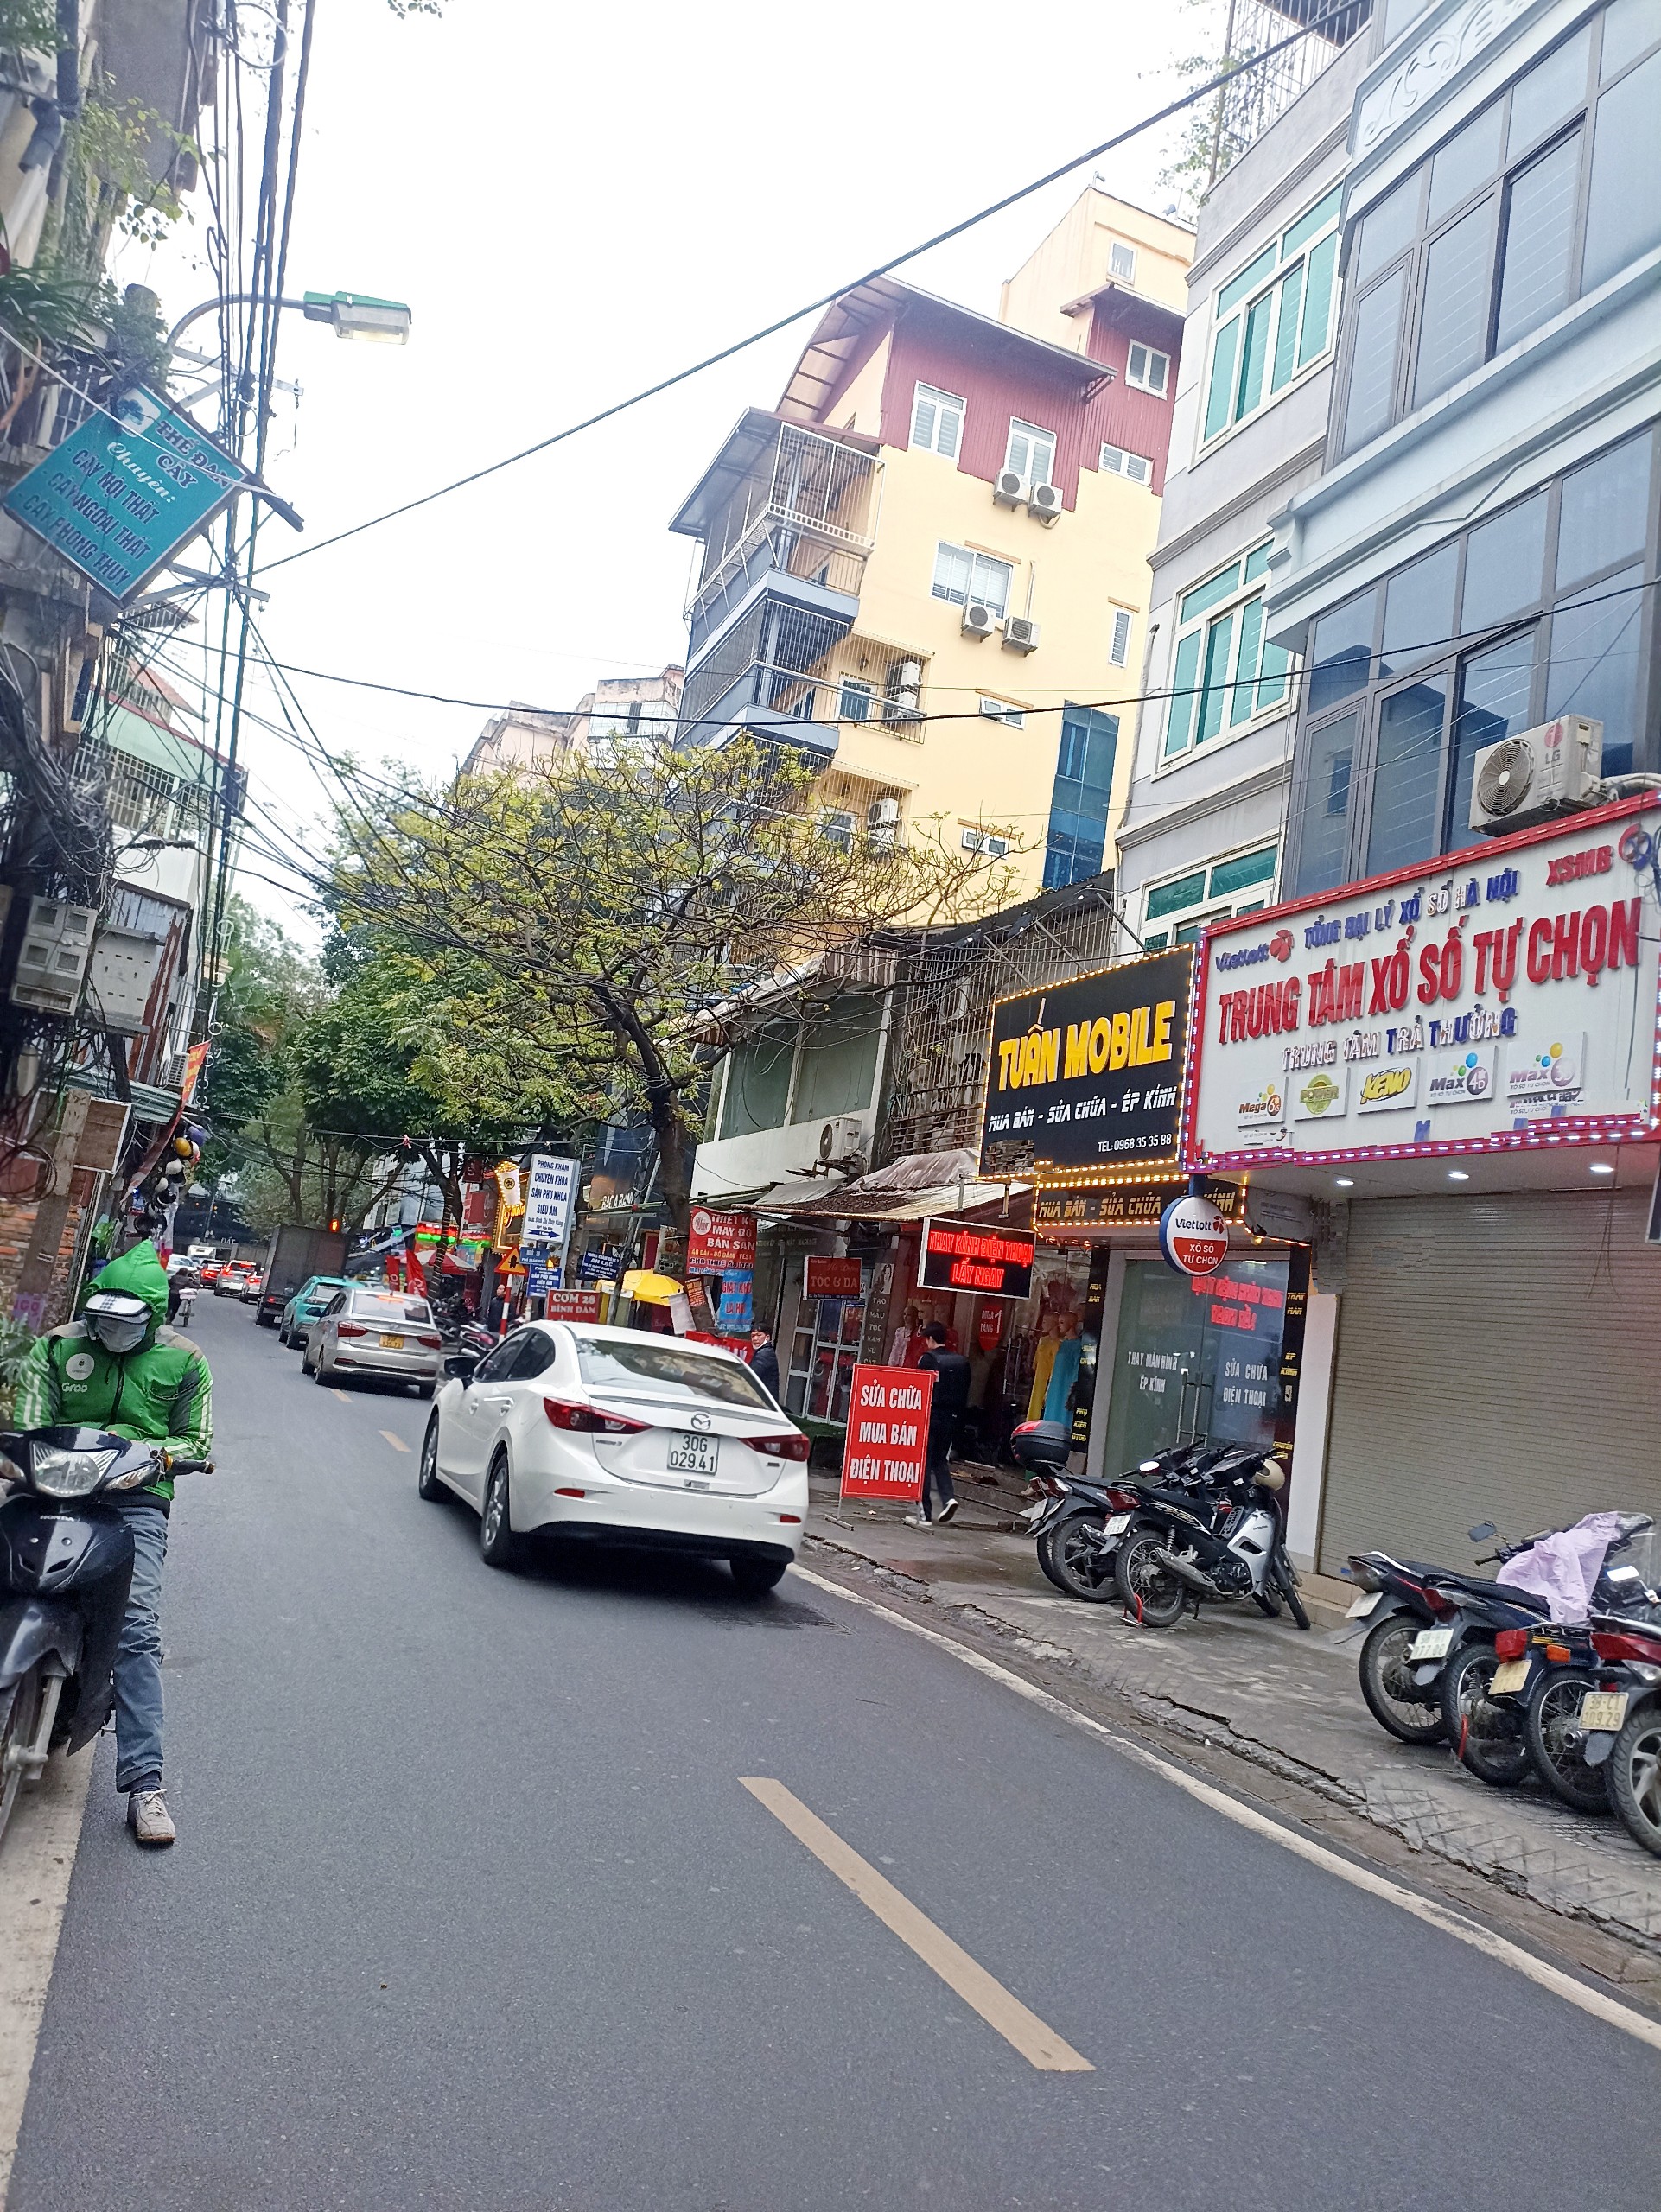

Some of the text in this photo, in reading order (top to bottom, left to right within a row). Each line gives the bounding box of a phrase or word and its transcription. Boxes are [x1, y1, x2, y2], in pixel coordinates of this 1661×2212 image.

[72, 448, 161, 524] CÂY NỘI THẤT
[52, 515, 99, 560] PHONG
[113, 525, 151, 561] THẤT
[1545, 749, 1561, 765] LG
[1546, 844, 1613, 887] XSMB
[1454, 878, 1480, 909] HÀ
[1486, 867, 1520, 903] NỘI
[1219, 896, 1644, 1045] TRUNG TÂM XỔ SỐ TỰ CHỌN
[998, 998, 1175, 1090] TUẤN MOBILE
[1282, 1003, 1518, 1071] TRUNG TÂM TRẢ THƯỞNG
[1360, 1067, 1412, 1104] KENO
[1429, 1077, 1465, 1092] Max
[1510, 1068, 1549, 1084] Max
[988, 1084, 1177, 1132] MUA BÁN SỬA CHỮA ÉP KÍNH
[1238, 1103, 1267, 1115] Mega
[1136, 1136, 1147, 1148] 35
[1148, 1135, 1159, 1147] 35
[1161, 1134, 1172, 1145] 88
[555, 1175, 568, 1186] KHOA
[553, 1192, 567, 1202] KHOA
[1039, 1200, 1061, 1217] MUA
[1099, 1192, 1124, 1216] SỬA
[1128, 1191, 1161, 1215] CHỮA
[712, 1225, 735, 1236] MAY
[1175, 1217, 1212, 1230] Vietlott
[707, 1236, 730, 1249] BÁN
[929, 1230, 1034, 1268] THAY KÍNH ĐIỆN THOẠI
[1189, 1240, 1215, 1254] XỔ SỐ
[810, 1274, 831, 1288] TÓC
[843, 1277, 858, 1288] DA
[952, 1257, 1004, 1288] LẤY NGAY
[582, 1294, 595, 1305] 28
[1128, 1351, 1144, 1366] THAY
[1225, 1357, 1268, 1381] SỬA CHỮA
[62, 1382, 87, 1392] Grab
[1140, 1374, 1166, 1393] ÉP KÍNH
[861, 1379, 922, 1410] SỬA CHỮA
[1224, 1386, 1266, 1409] ĐIỆN THOẠI
[682, 1435, 708, 1452] 30G
[859, 1421, 917, 1446] MUA BÁN
[671, 1451, 715, 1471] 029.41
[850, 1454, 920, 1488] ĐIỆN THOẠI
